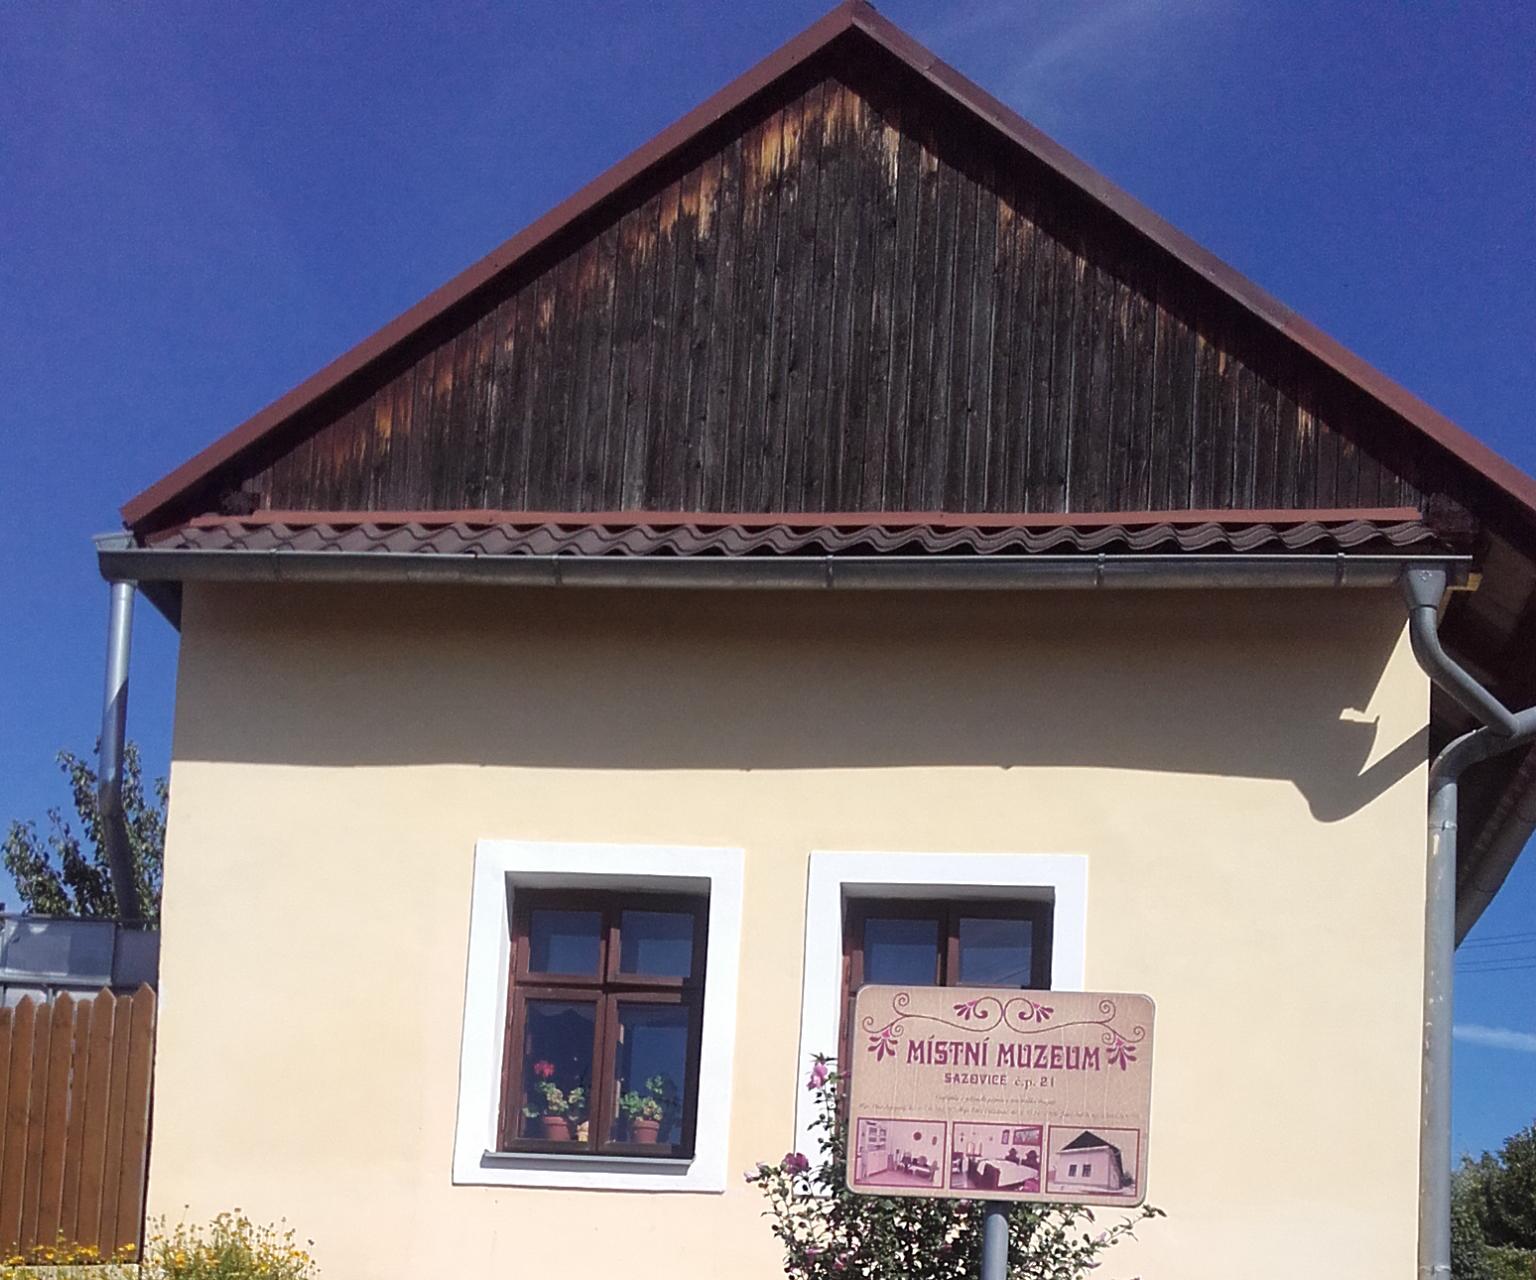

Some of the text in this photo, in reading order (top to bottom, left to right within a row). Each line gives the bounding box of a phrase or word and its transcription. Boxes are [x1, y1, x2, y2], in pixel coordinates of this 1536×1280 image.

[907, 1036, 1100, 1071] MÍSTNÍ MUZEUM
[944, 1073, 1007, 1086] SAZOVICE
[1040, 1076, 1055, 1088] 21
